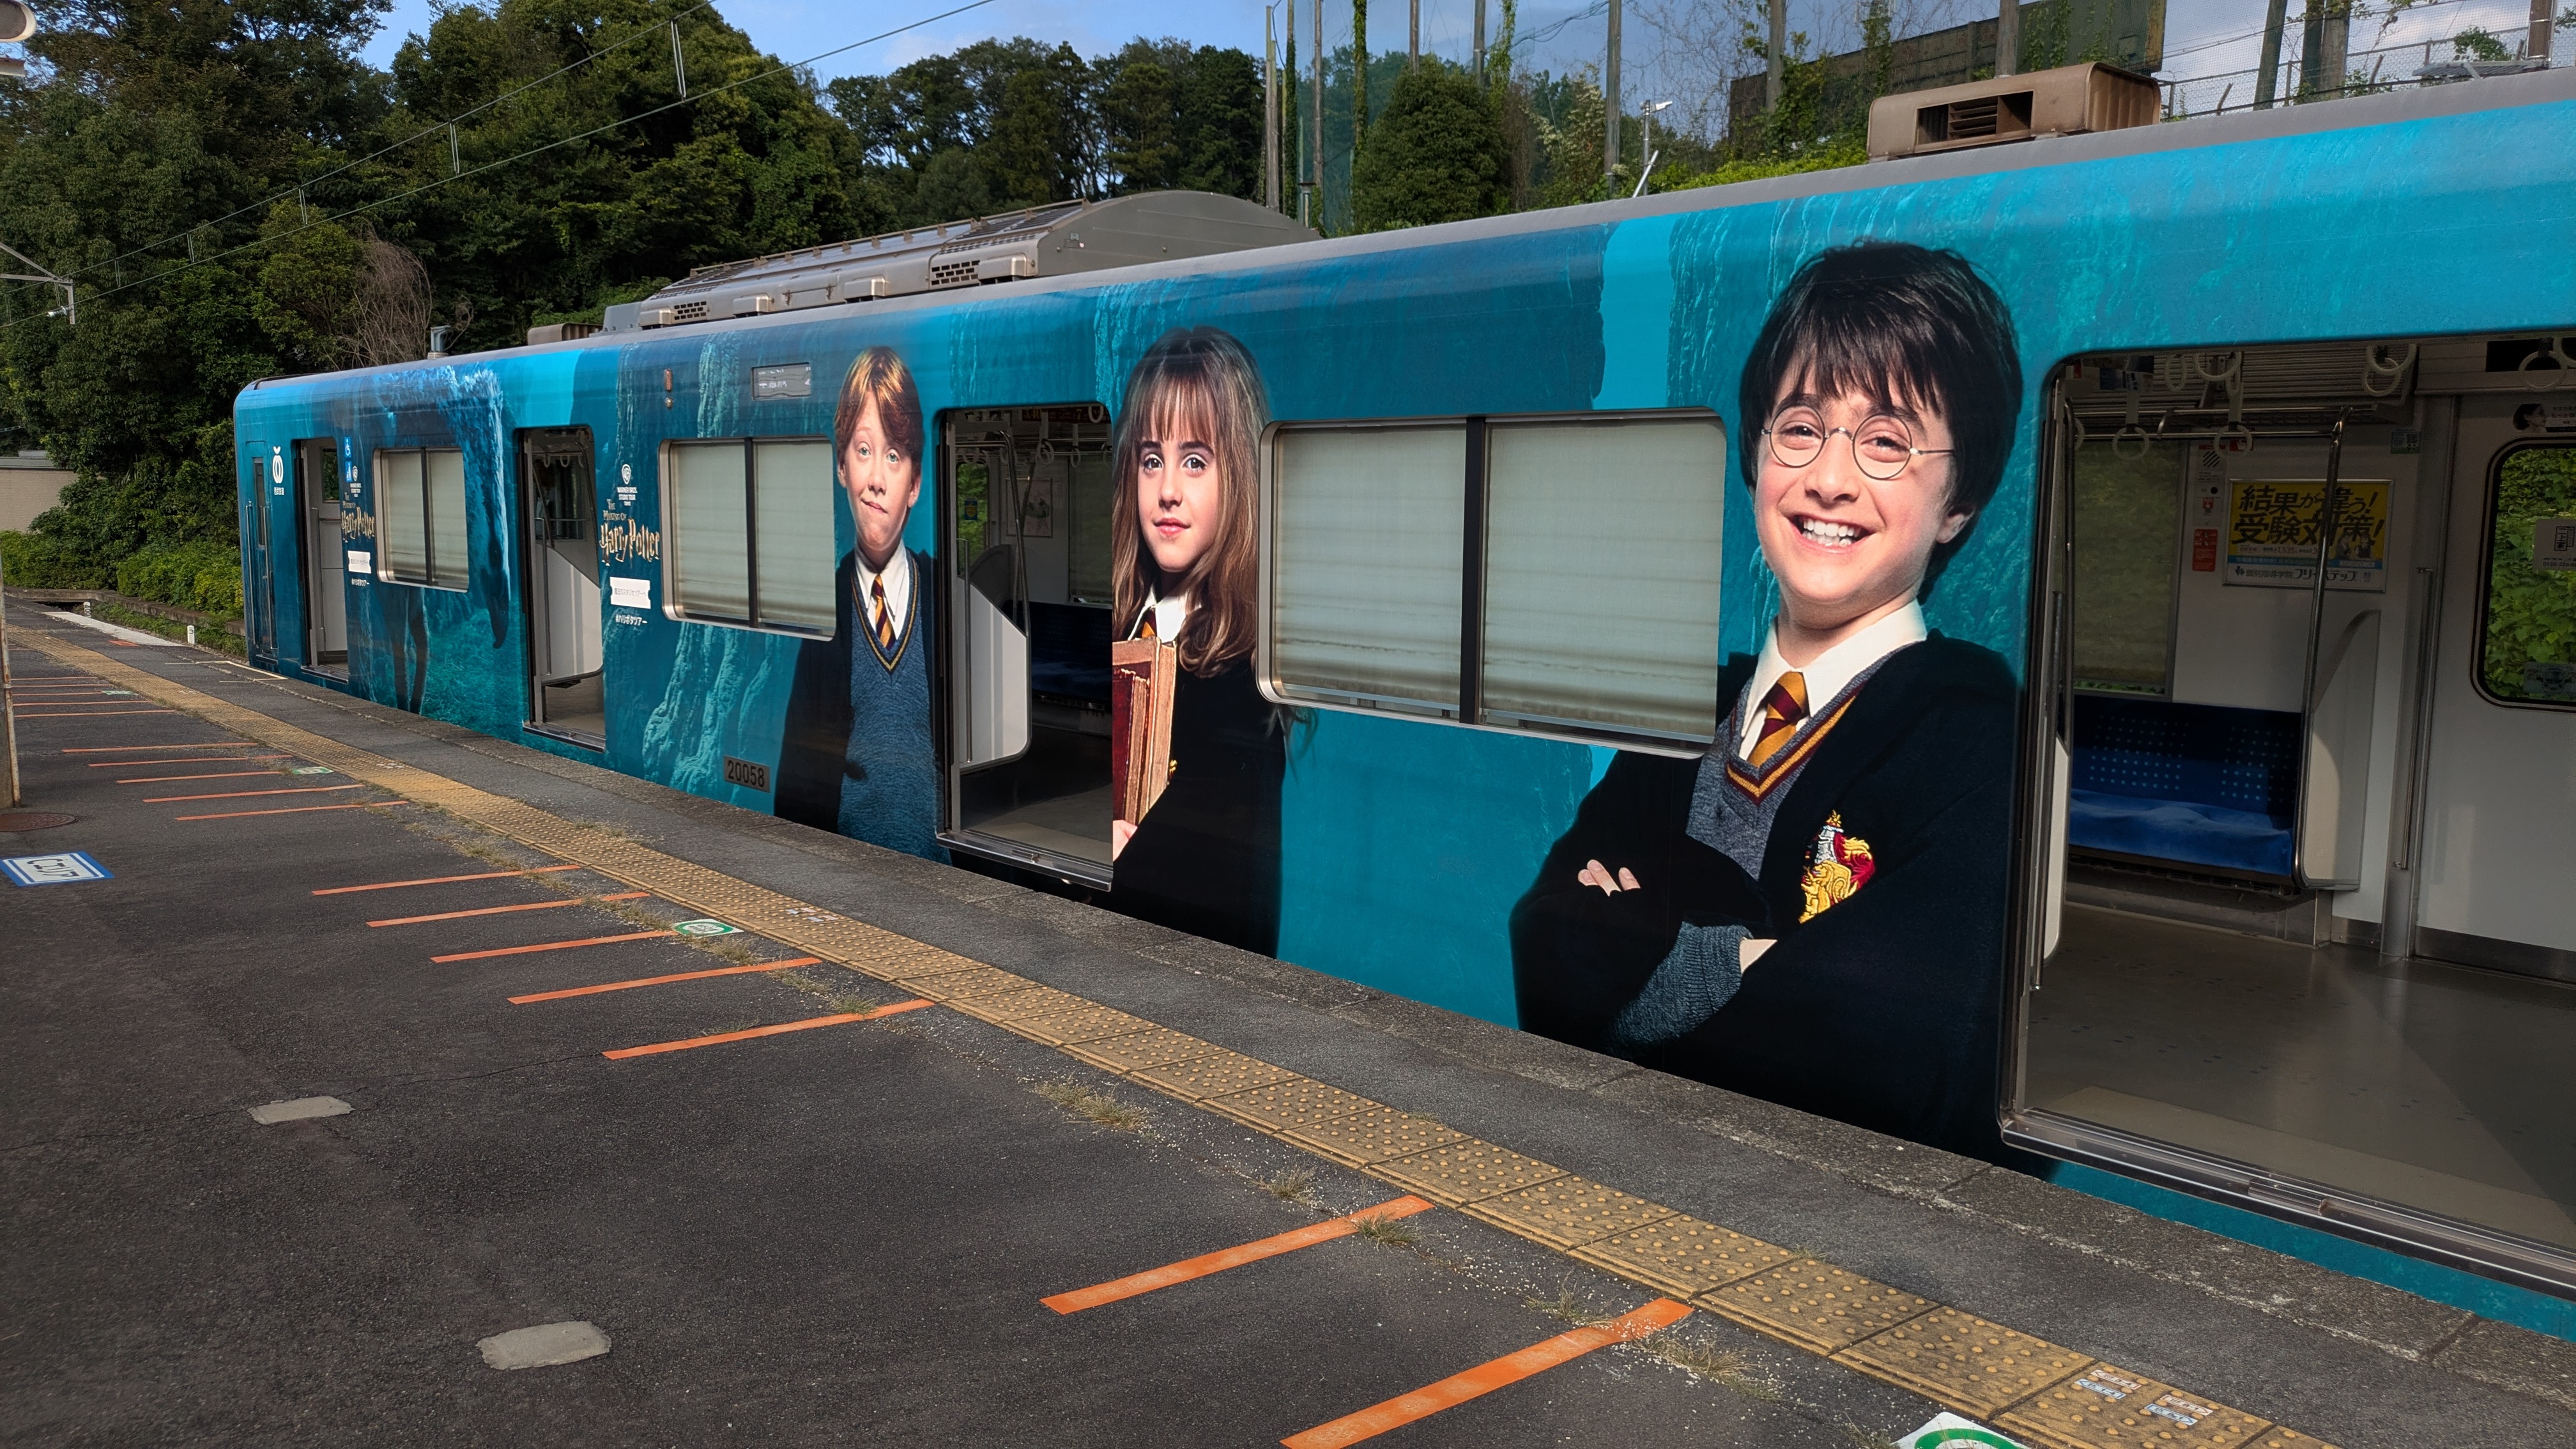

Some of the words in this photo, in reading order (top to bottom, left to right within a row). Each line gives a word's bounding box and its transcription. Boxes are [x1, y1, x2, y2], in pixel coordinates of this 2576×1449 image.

[599, 522, 628, 567] Harry
[628, 518, 660, 563] Potter
[727, 759, 765, 788] 20058
